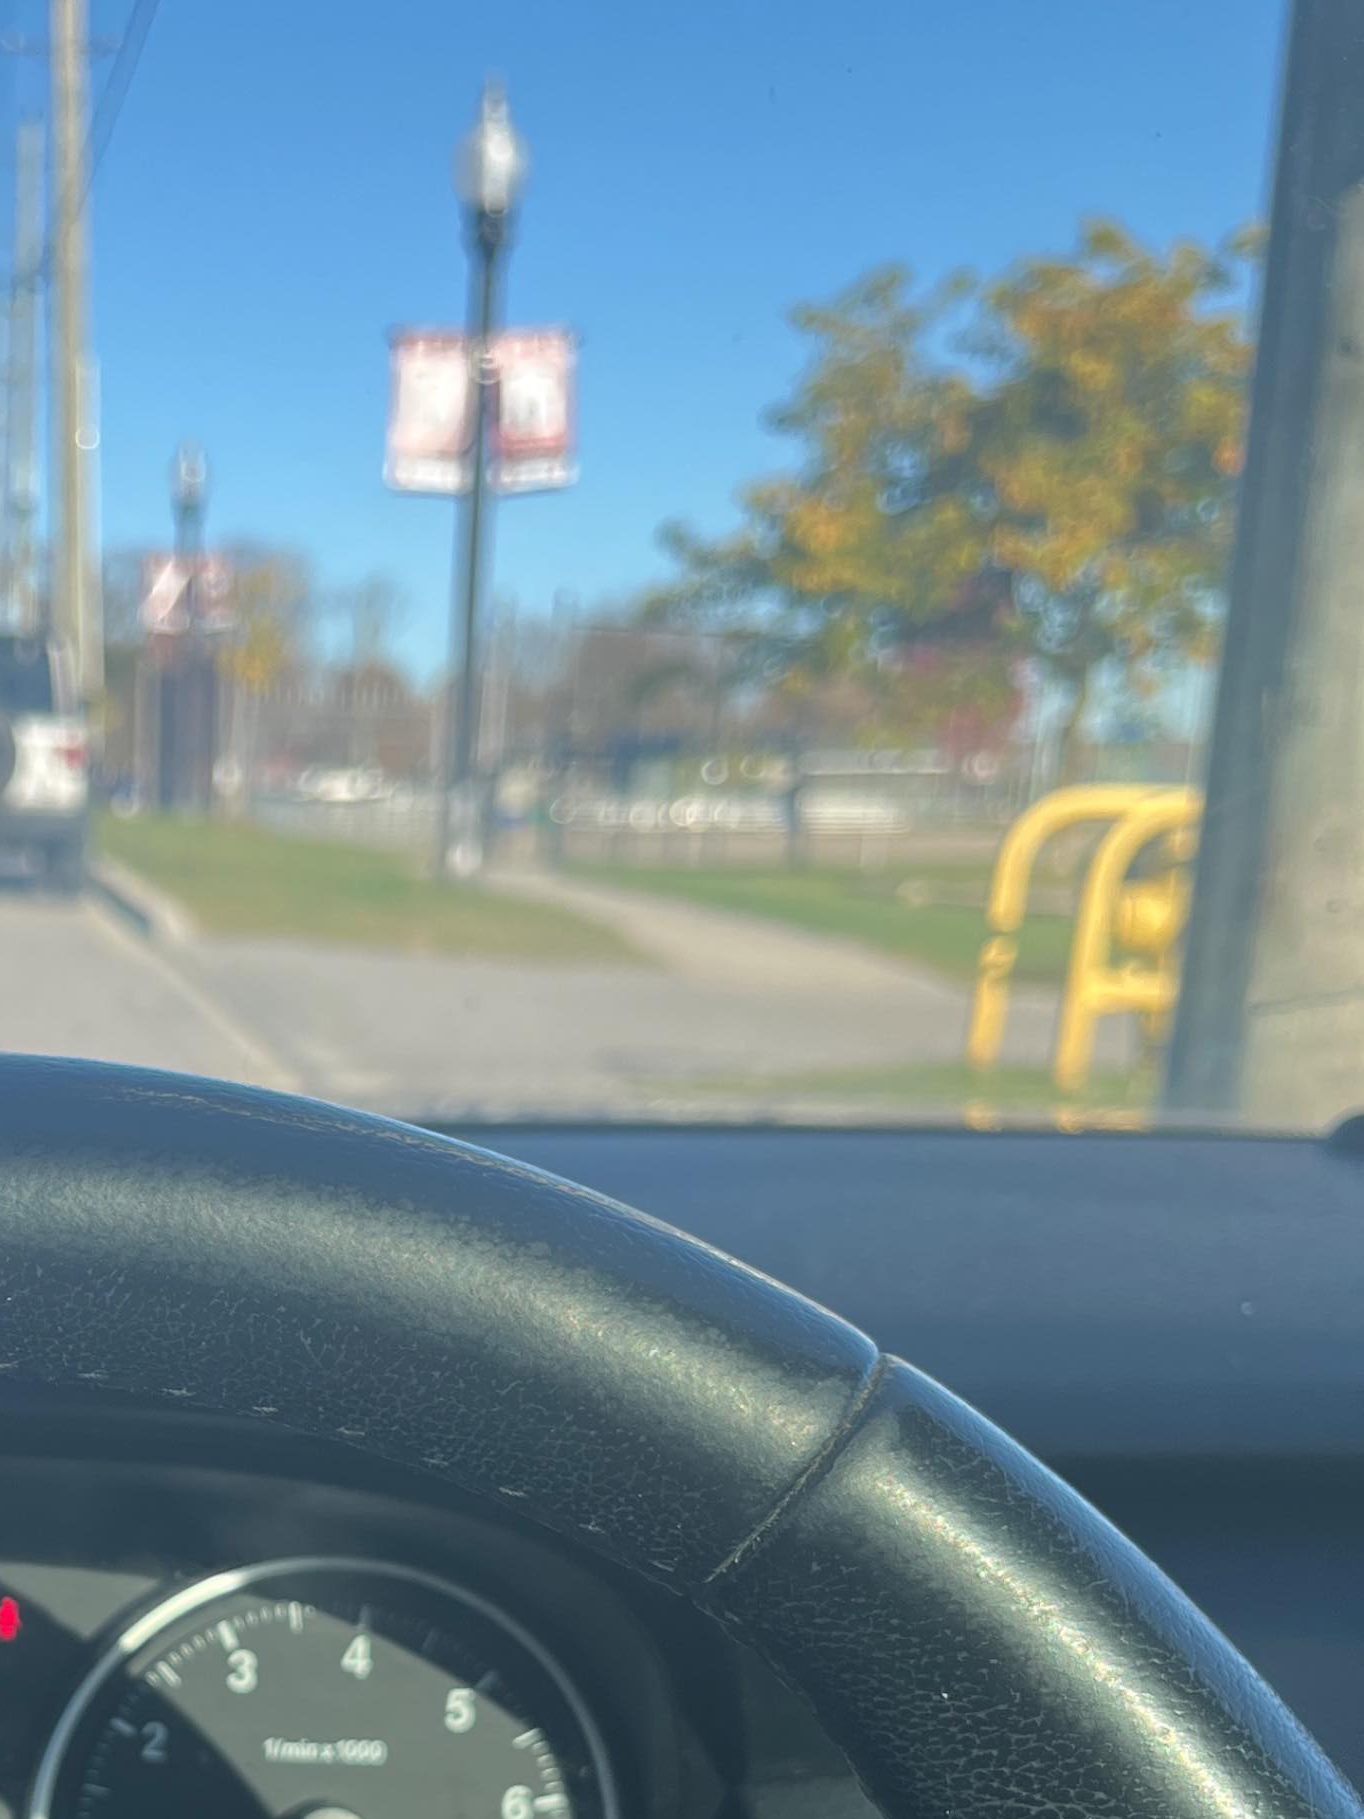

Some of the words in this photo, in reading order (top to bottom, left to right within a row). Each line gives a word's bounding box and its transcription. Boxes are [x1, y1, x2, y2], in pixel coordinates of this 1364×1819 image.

[226, 1649, 258, 1693] 3
[340, 1634, 373, 1679] 4
[444, 1688, 476, 1733] 5
[141, 1721, 168, 1764] 2
[336, 1738, 387, 1767] 1000
